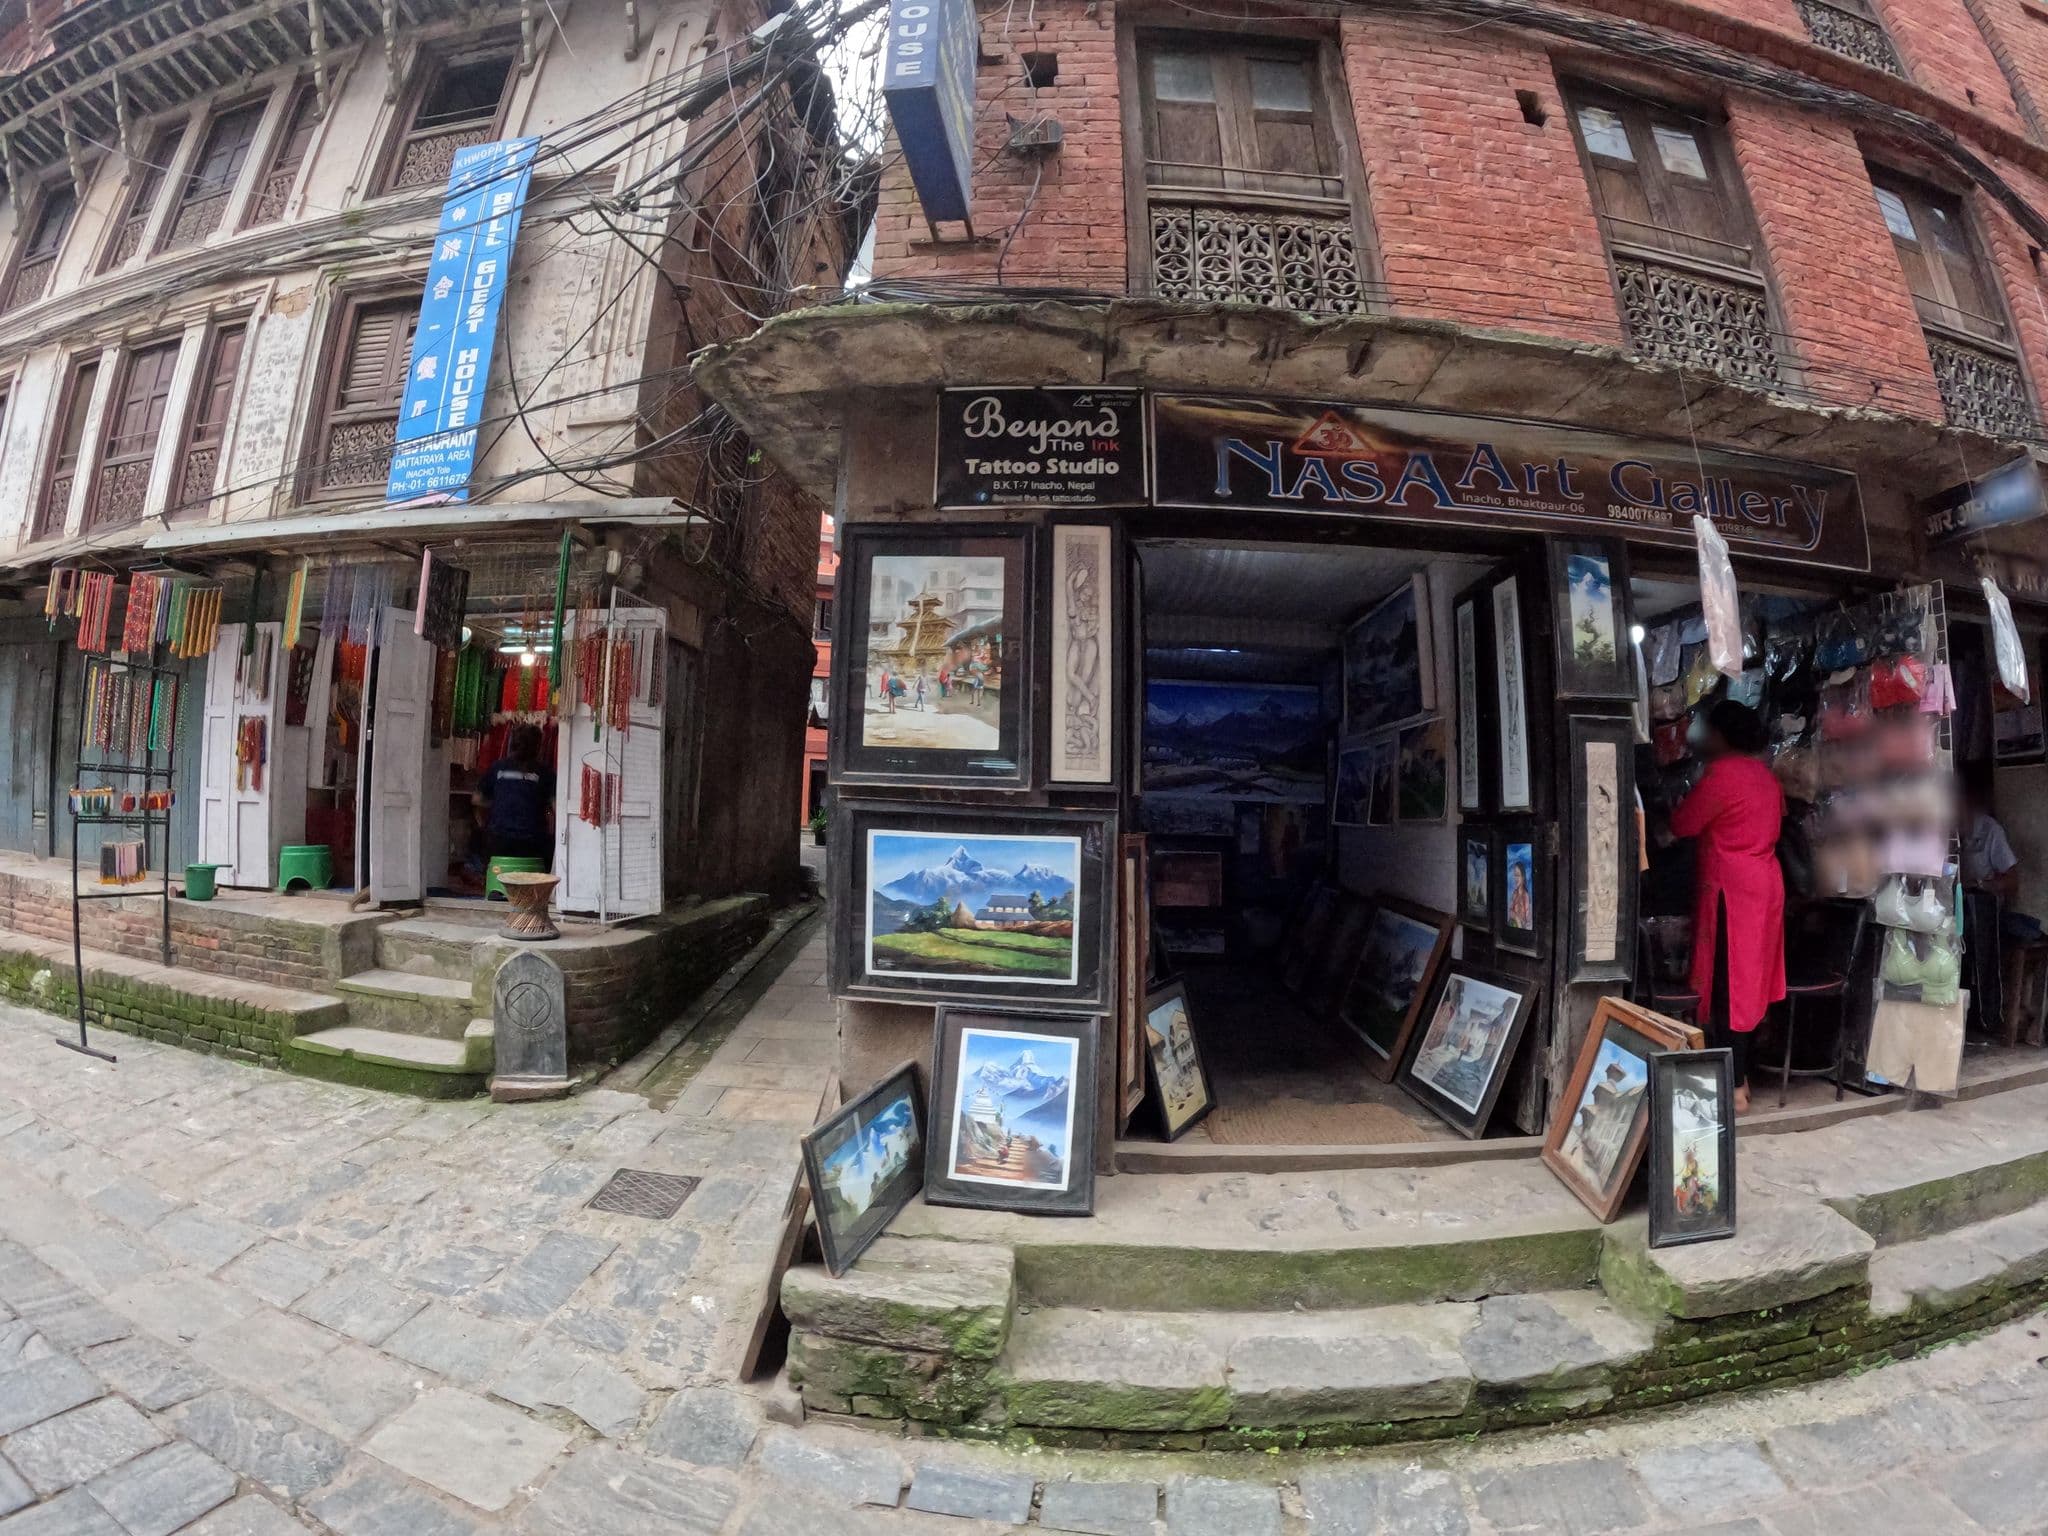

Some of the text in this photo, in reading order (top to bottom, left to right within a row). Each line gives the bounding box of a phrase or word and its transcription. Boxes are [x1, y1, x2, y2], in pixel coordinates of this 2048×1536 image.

[896, 0, 930, 76] OUSE
[455, 142, 504, 169] KHWOPA
[485, 191, 514, 247] BELL
[466, 259, 497, 334] GUEST
[447, 346, 479, 428] HOUSE
[963, 396, 1120, 455] Beyond
[1048, 438, 1120, 452] The Ink
[394, 449, 471, 469] DATTATRAYA AREA
[405, 467, 436, 478] INACHO
[965, 457, 1120, 475] Tattoo Studio
[1031, 480, 1066, 491] Inacho,
[1067, 481, 1096, 491] Nepal
[1214, 437, 1828, 551] NASA Art Gallery
[1462, 492, 1587, 514] Inacho, Bhaktpaur-06
